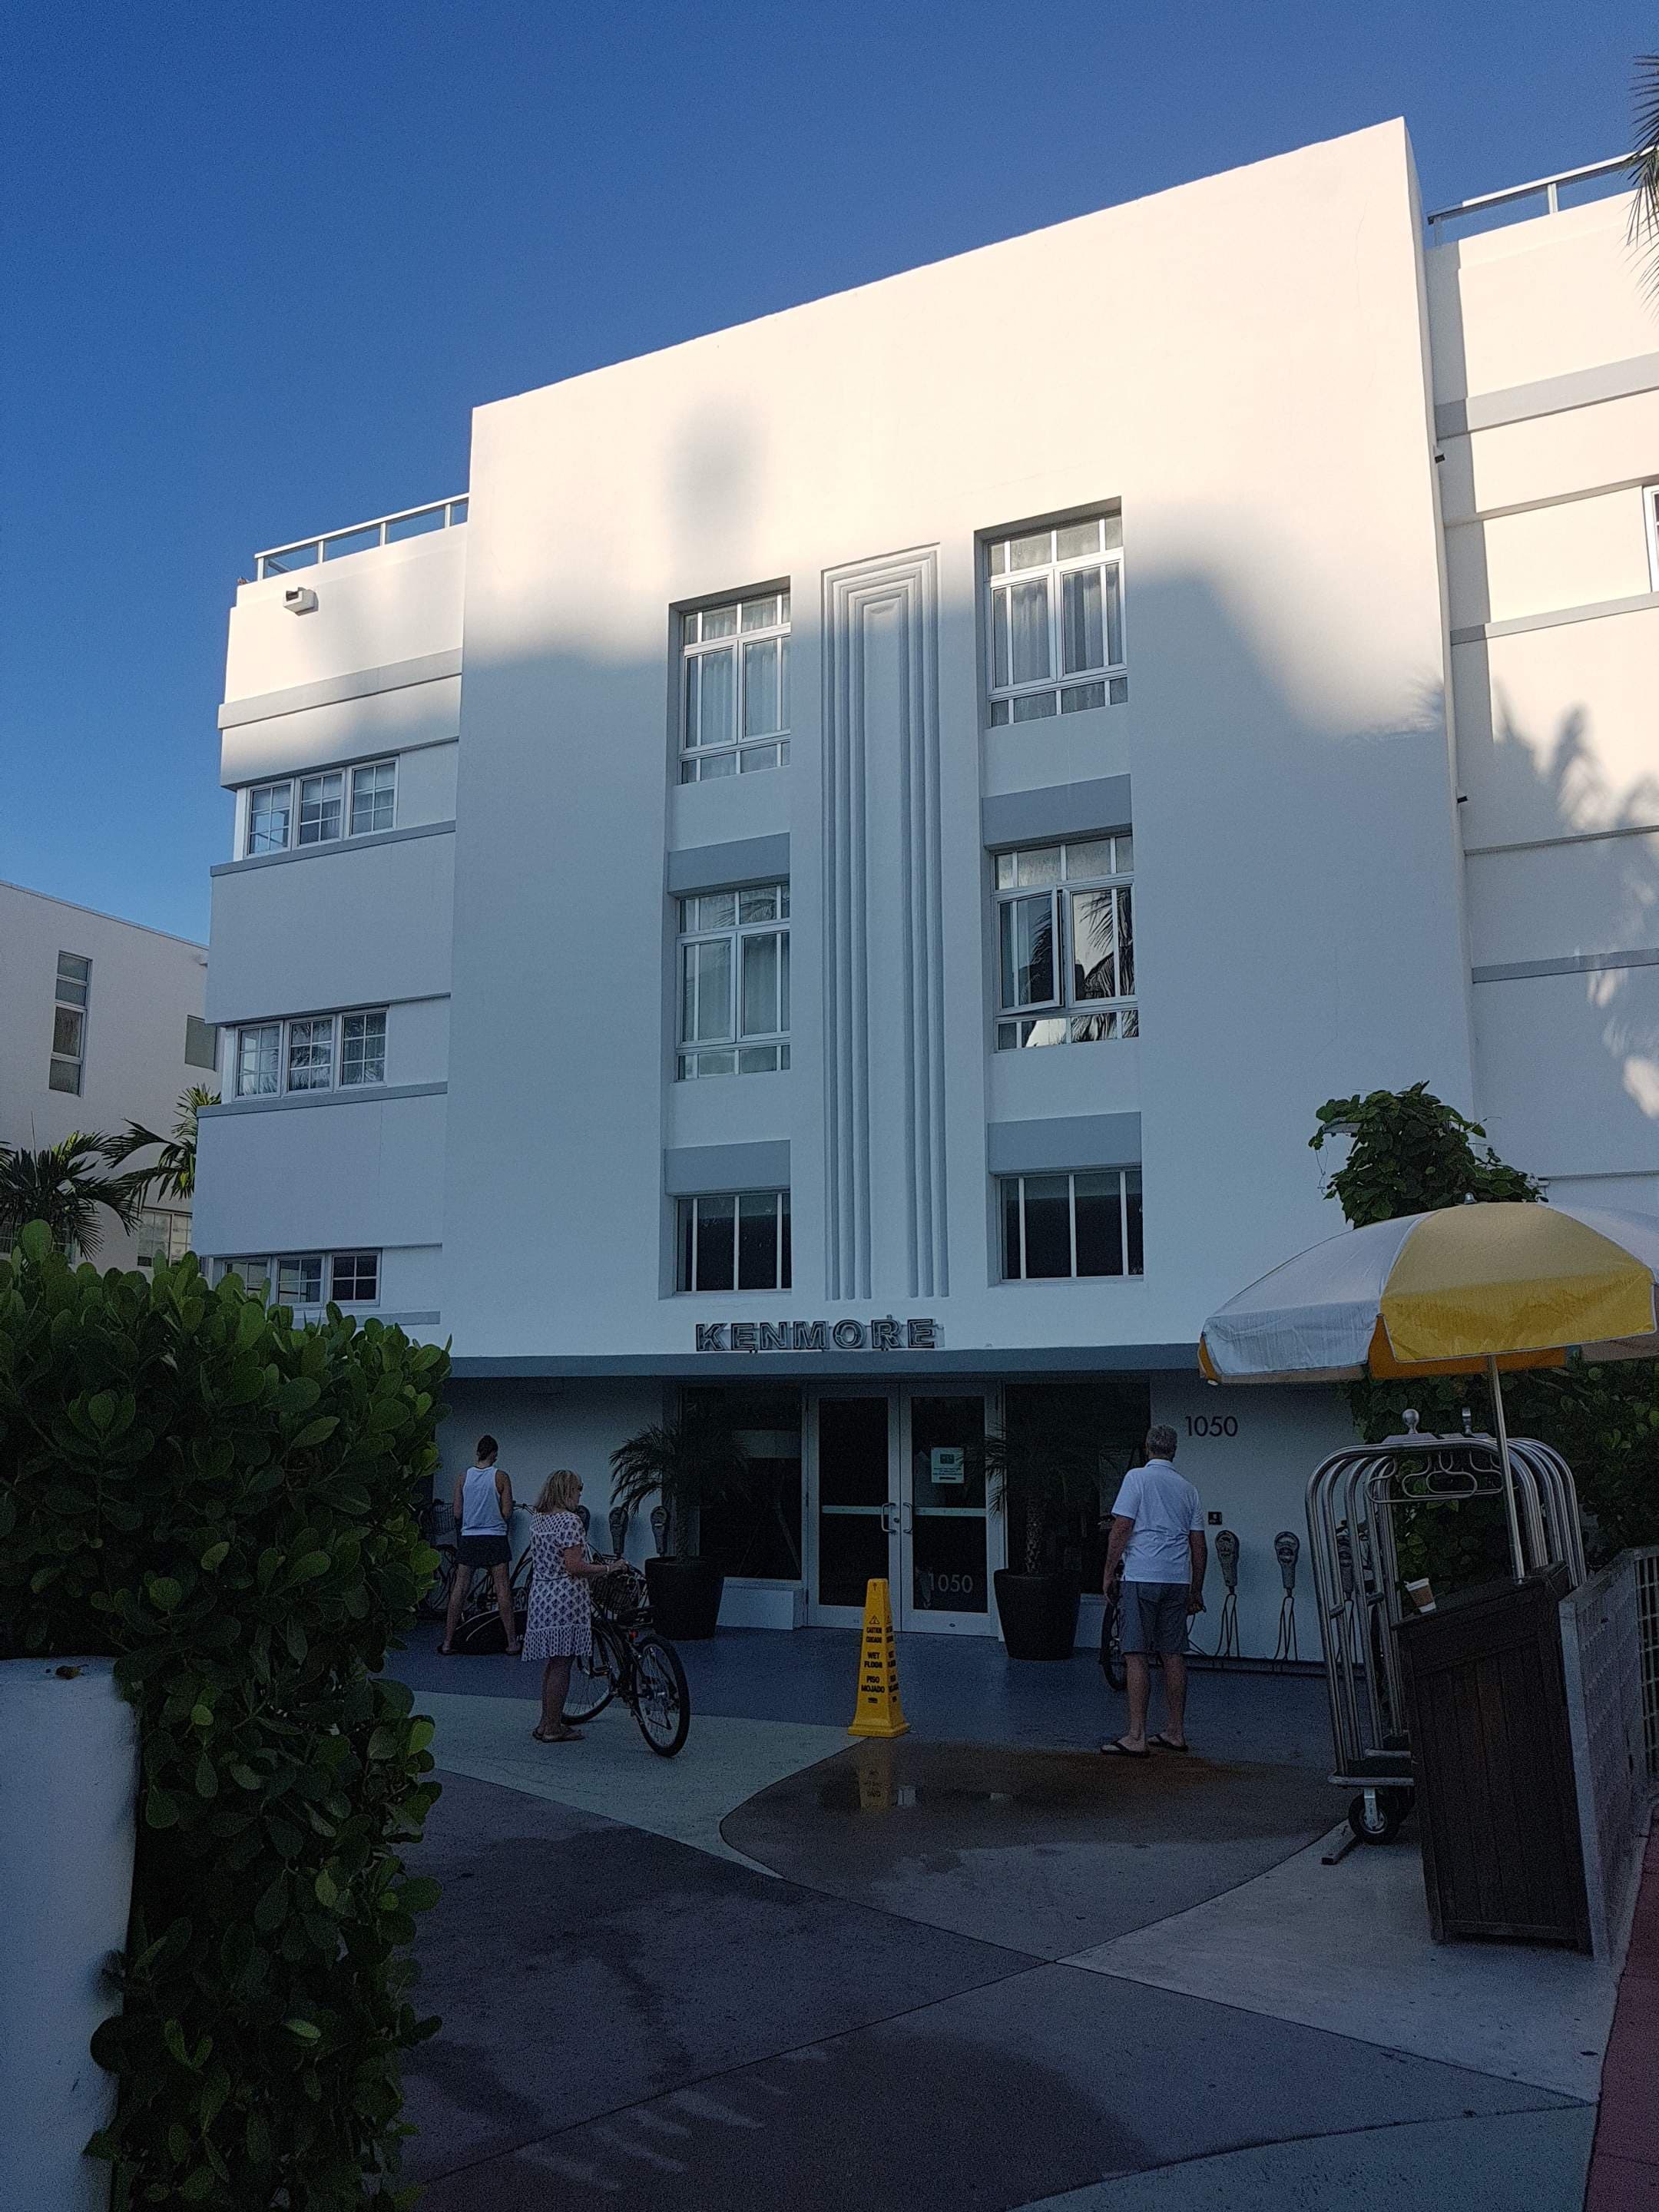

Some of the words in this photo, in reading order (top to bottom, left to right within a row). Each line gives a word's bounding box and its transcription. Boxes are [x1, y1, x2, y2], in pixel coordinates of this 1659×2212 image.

[695, 1319, 935, 1352] KENMORE
[1185, 1416, 1238, 1437] 1050
[928, 1574, 973, 1593] 1050
[861, 1684, 885, 1693] MOJADO
[866, 1675, 880, 1684] PISO
